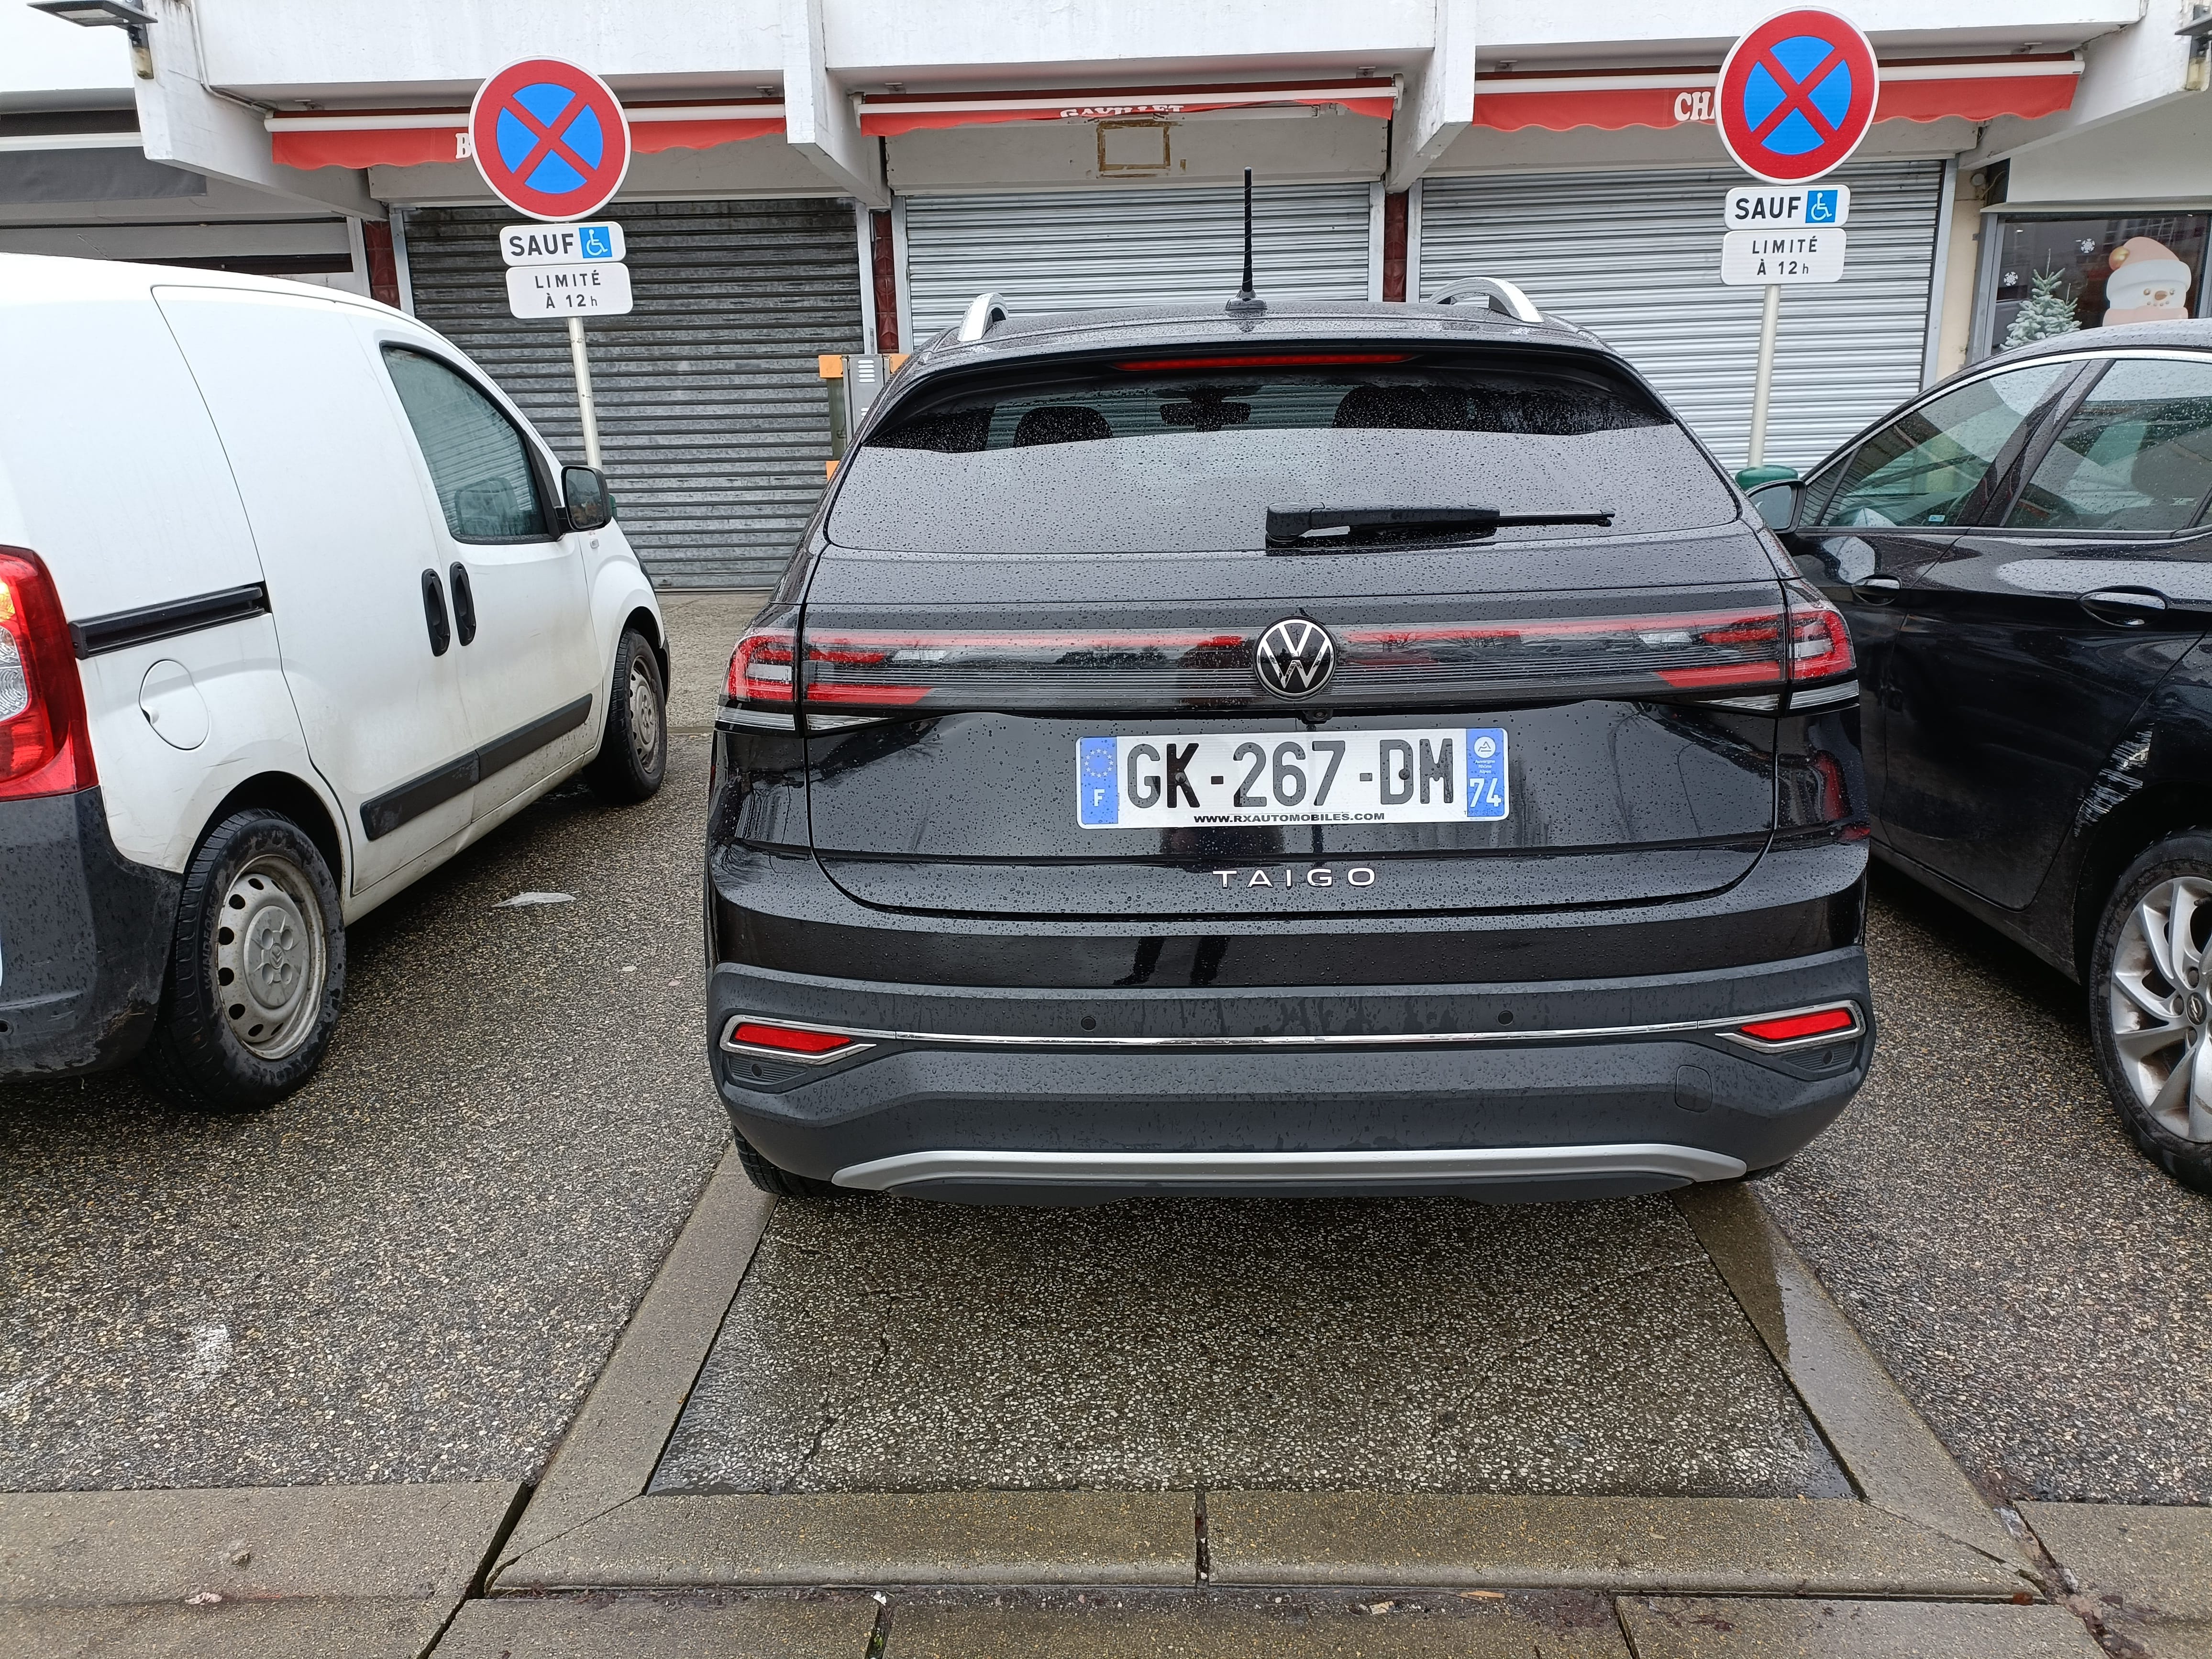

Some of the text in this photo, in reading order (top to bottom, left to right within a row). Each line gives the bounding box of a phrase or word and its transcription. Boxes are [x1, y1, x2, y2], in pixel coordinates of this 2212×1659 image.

[1735, 197, 1801, 219] SAUF
[509, 233, 574, 256] SAUF
[1752, 236, 1818, 254] LIMITÉ
[1757, 259, 1809, 275] À 12h
[535, 270, 601, 288] LIMITÉ
[546, 293, 597, 309] À 12h
[1094, 789, 1105, 807] F
[1469, 778, 1502, 807] 74
[1194, 813, 1385, 823] WWW.RXAUTOMOBILES.COM
[1213, 867, 1375, 888] TAIGO
